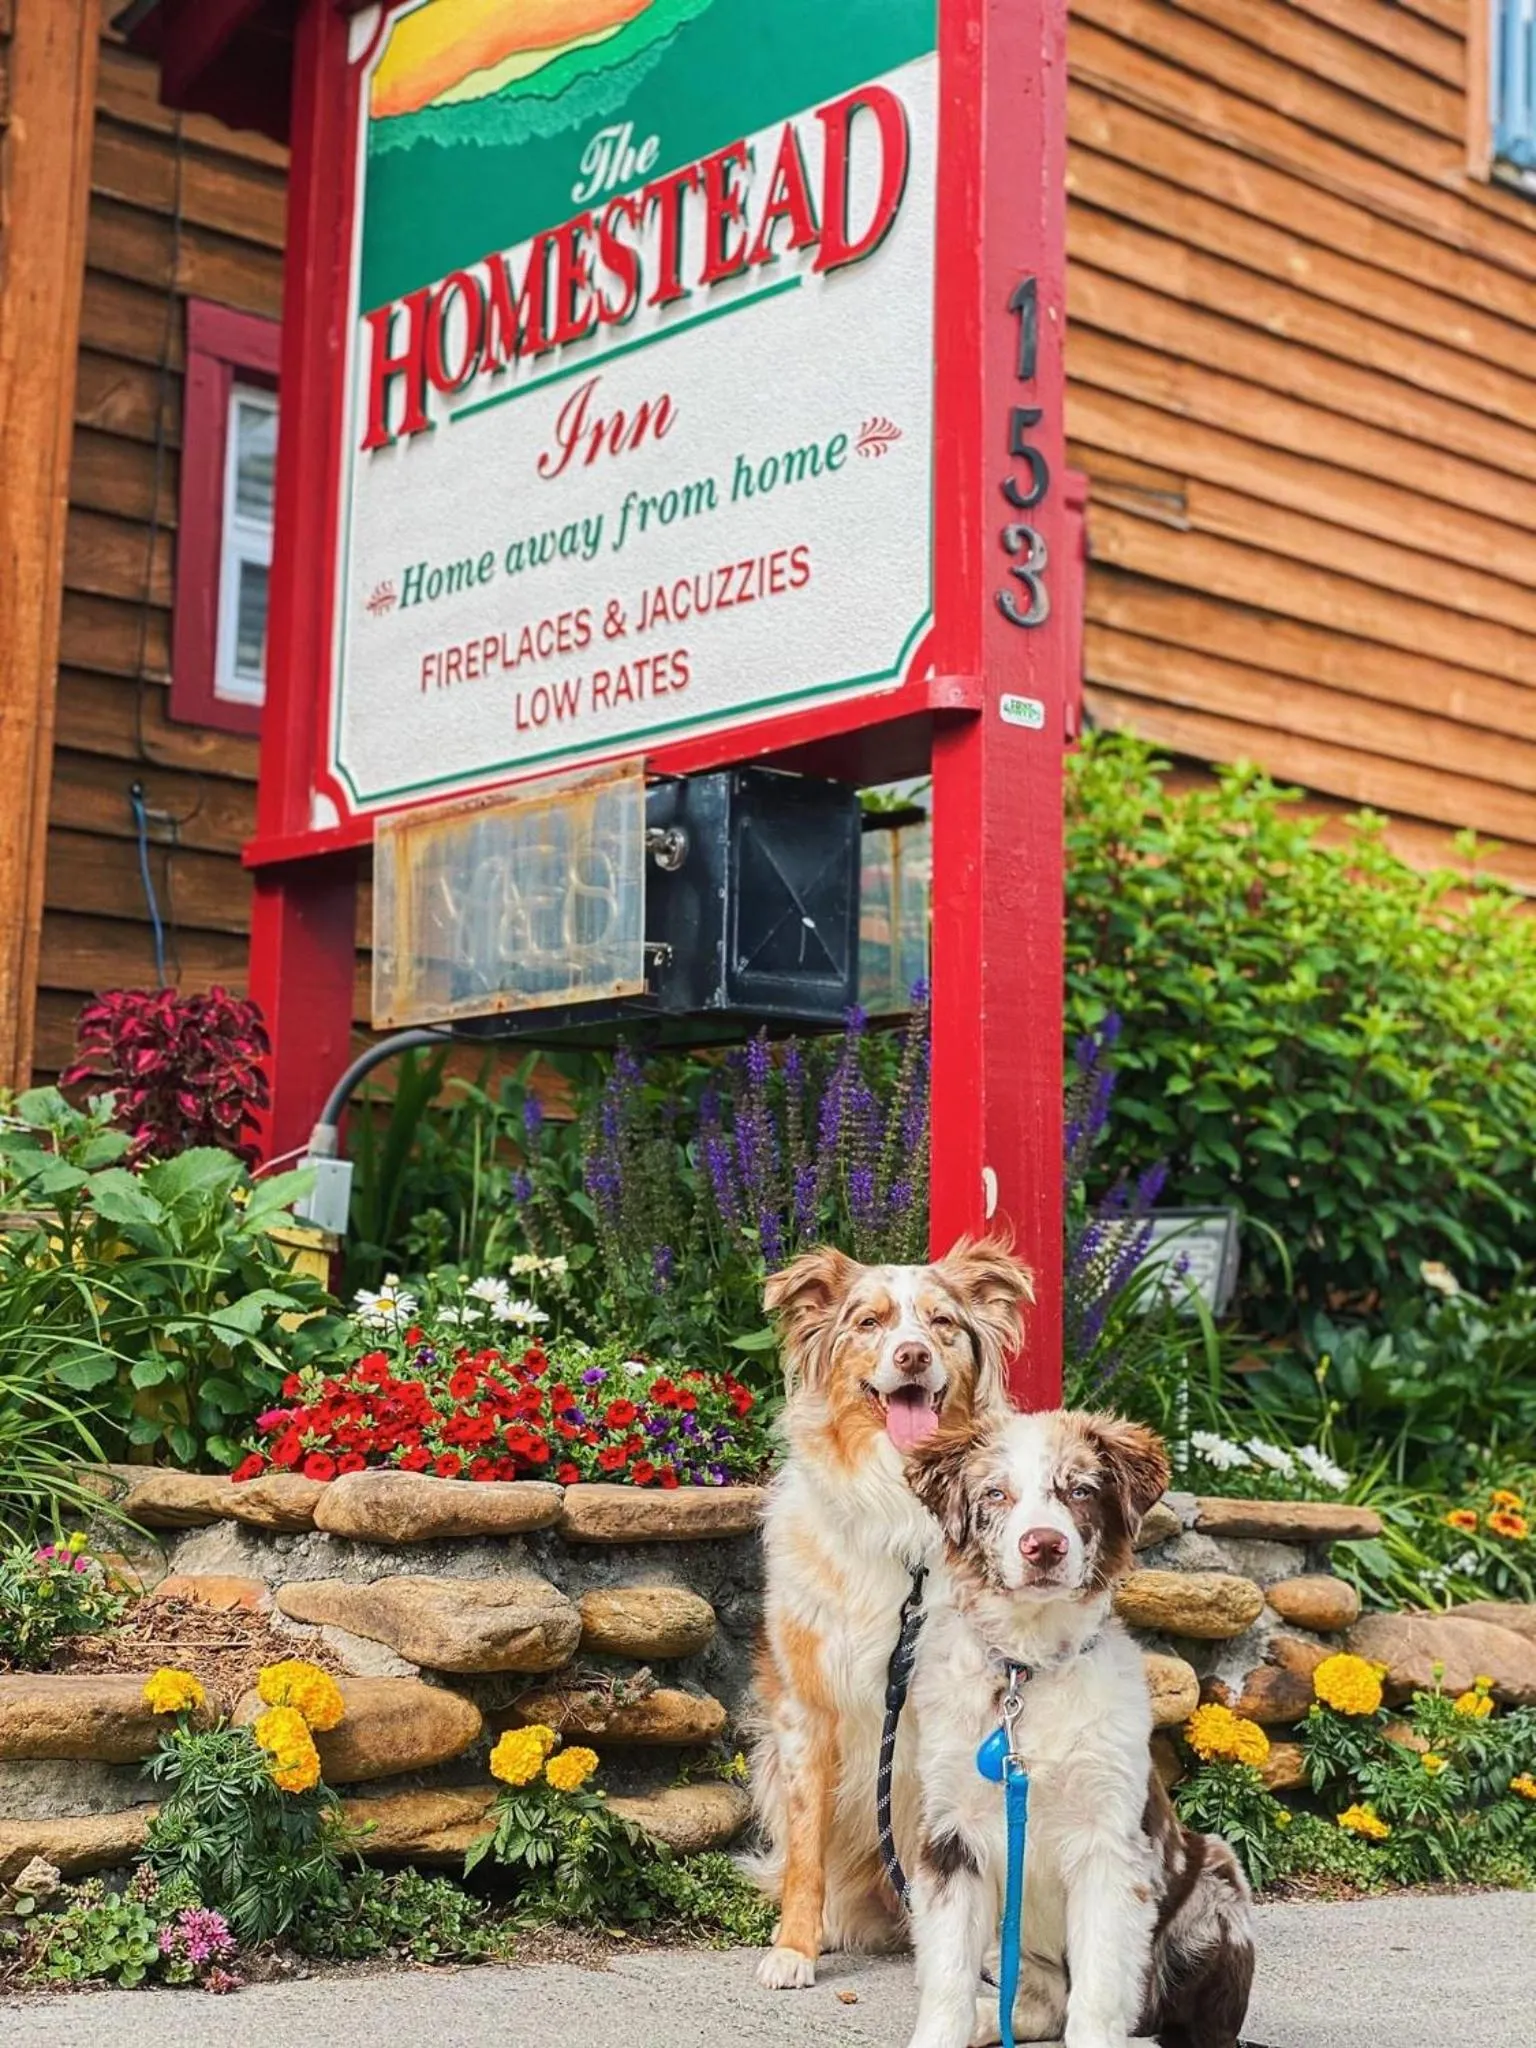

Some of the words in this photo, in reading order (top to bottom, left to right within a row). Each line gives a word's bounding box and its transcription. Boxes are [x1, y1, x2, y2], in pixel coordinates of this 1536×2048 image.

[571, 121, 660, 203] The
[359, 85, 911, 453] HOMESTEAD
[537, 376, 679, 480] Inn
[399, 550, 495, 610] Home
[505, 512, 604, 576] away
[612, 474, 718, 553] from
[731, 432, 848, 503] home
[421, 607, 593, 693] FIREPLACES
[603, 601, 627, 640] &
[635, 545, 812, 635] JACUZZIES
[514, 677, 583, 731] LOW
[592, 649, 691, 711] RATES
